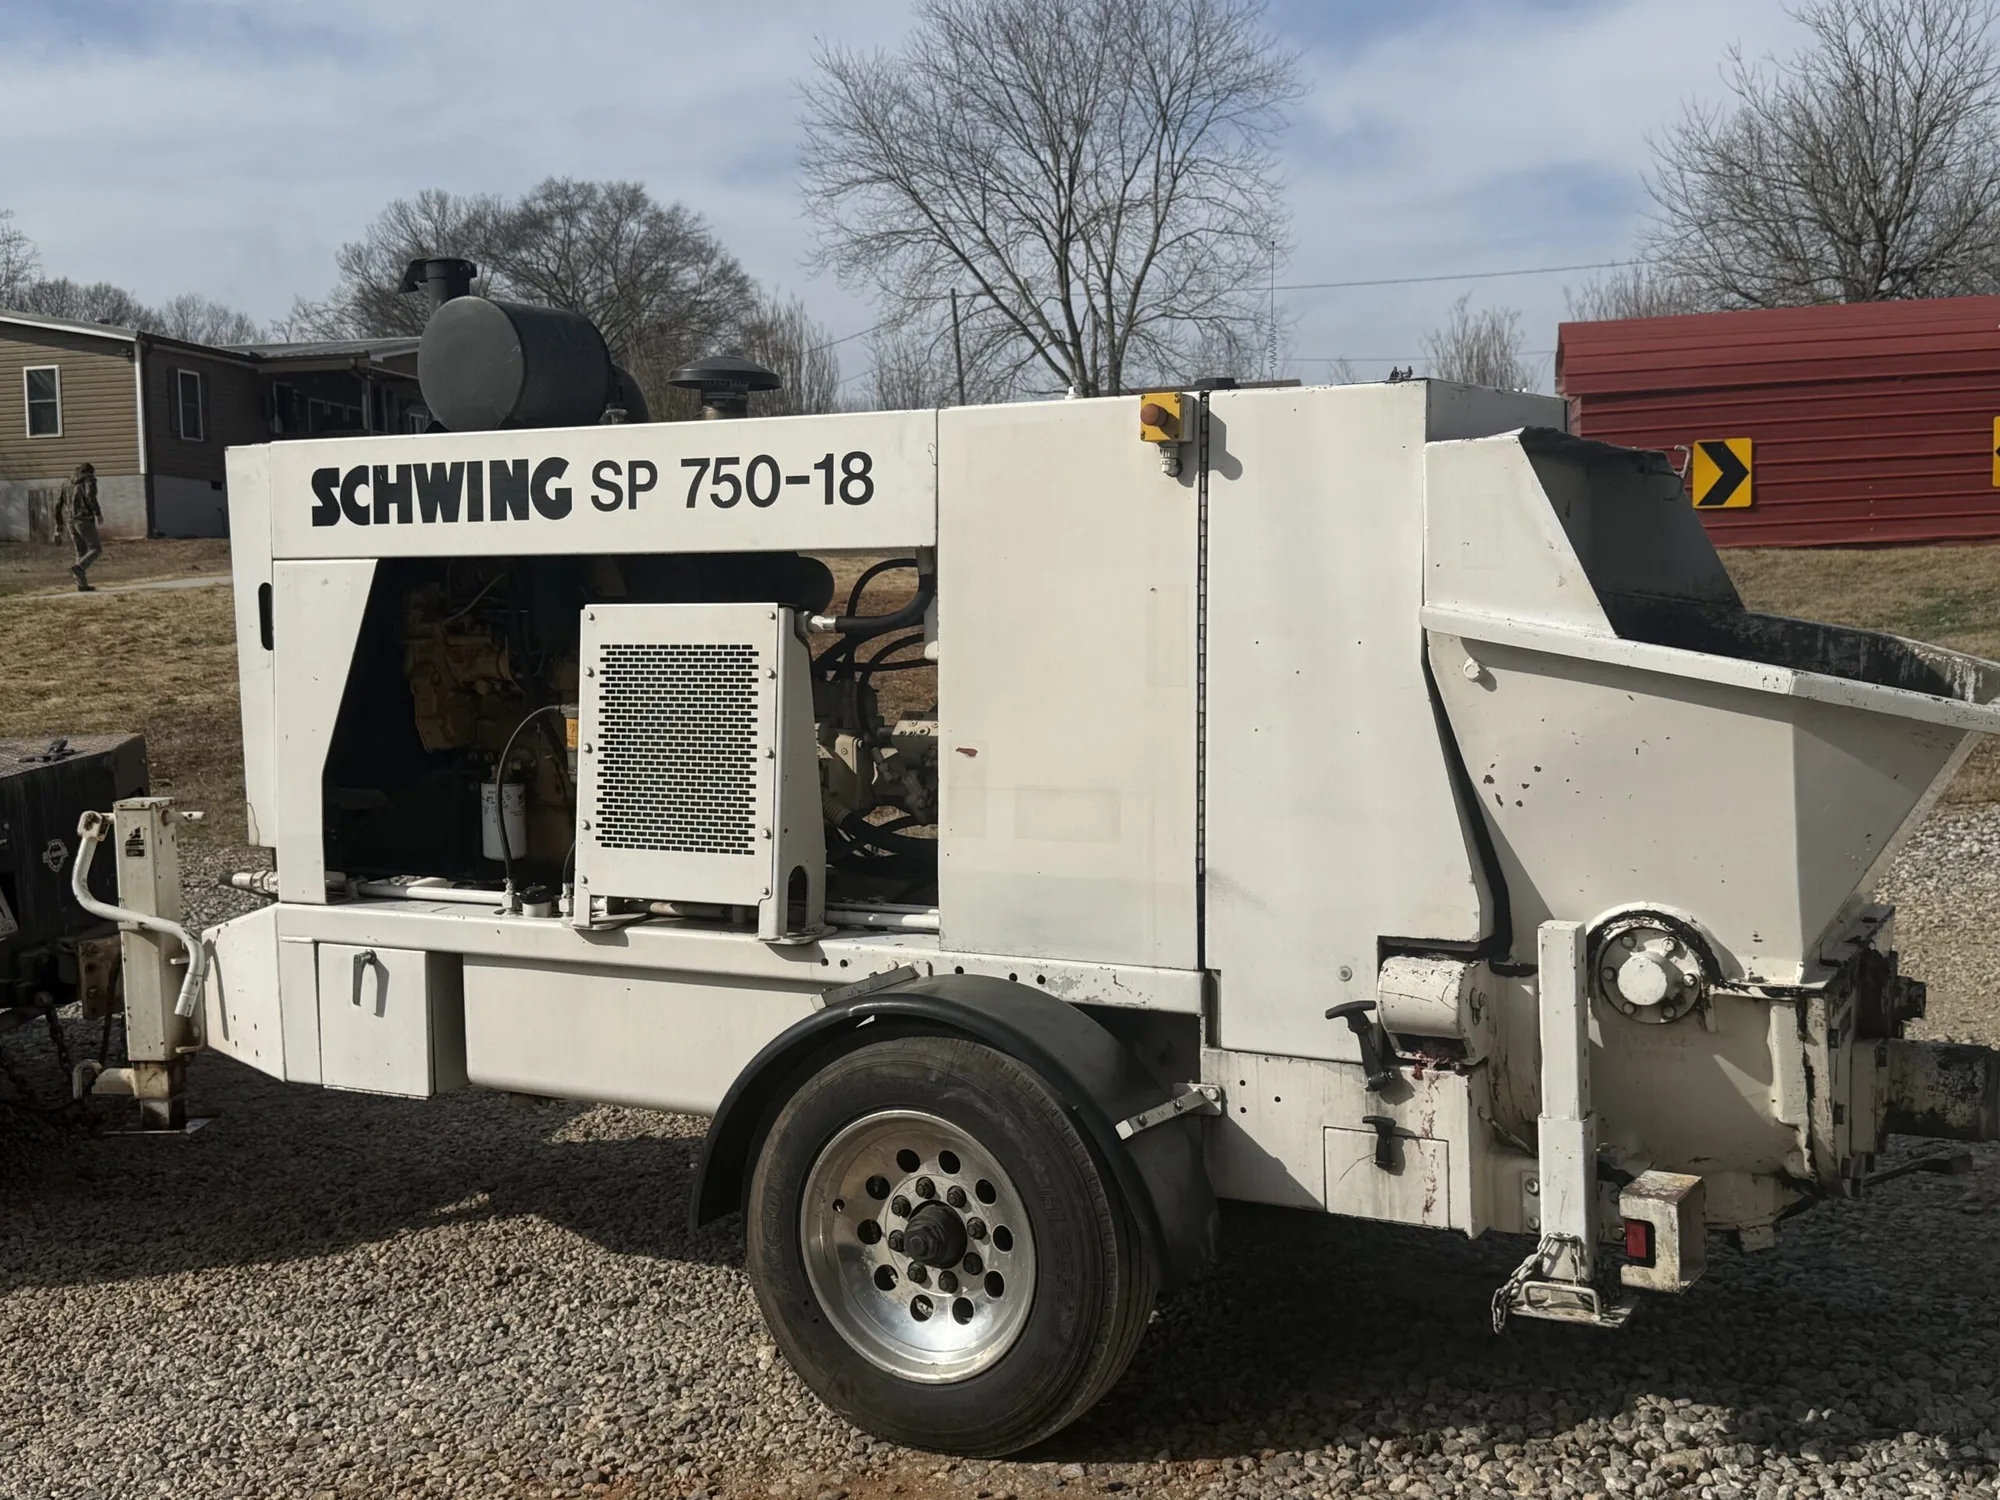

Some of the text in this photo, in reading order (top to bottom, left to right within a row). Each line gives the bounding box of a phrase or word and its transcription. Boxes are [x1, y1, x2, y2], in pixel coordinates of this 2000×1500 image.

[312, 451, 874, 526] SCHWING SP 750-18
